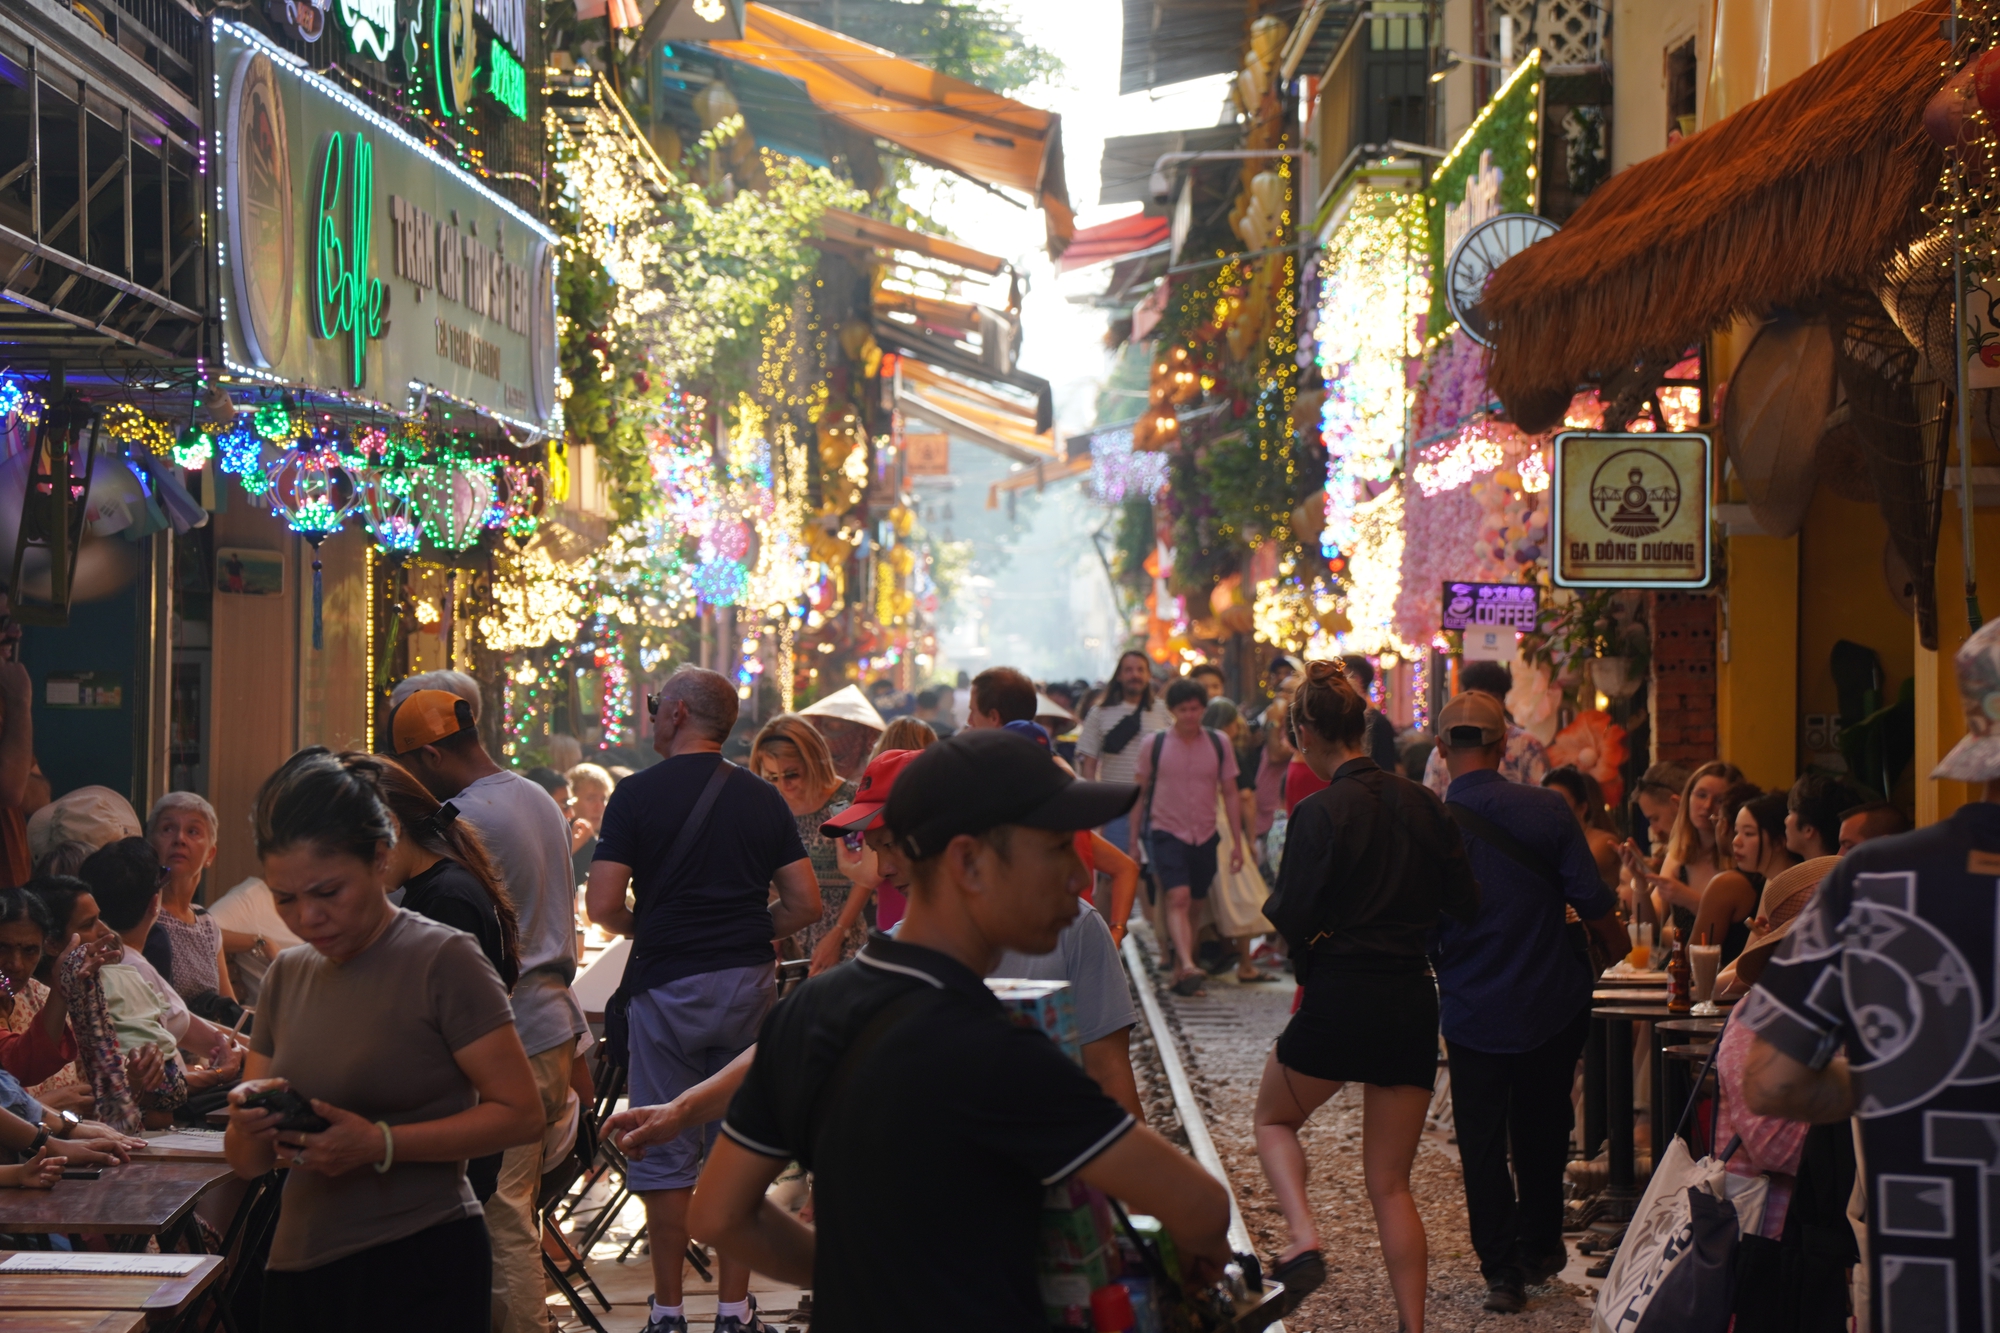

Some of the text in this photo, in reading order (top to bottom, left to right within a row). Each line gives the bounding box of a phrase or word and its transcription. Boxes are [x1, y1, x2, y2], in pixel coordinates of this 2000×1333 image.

[391, 194, 433, 303] TRẠM
[449, 323, 471, 369] TRAIN
[1570, 539, 1694, 561] GA ĐÔNG DƯƠNG
[1476, 603, 1534, 627] COFFEE
